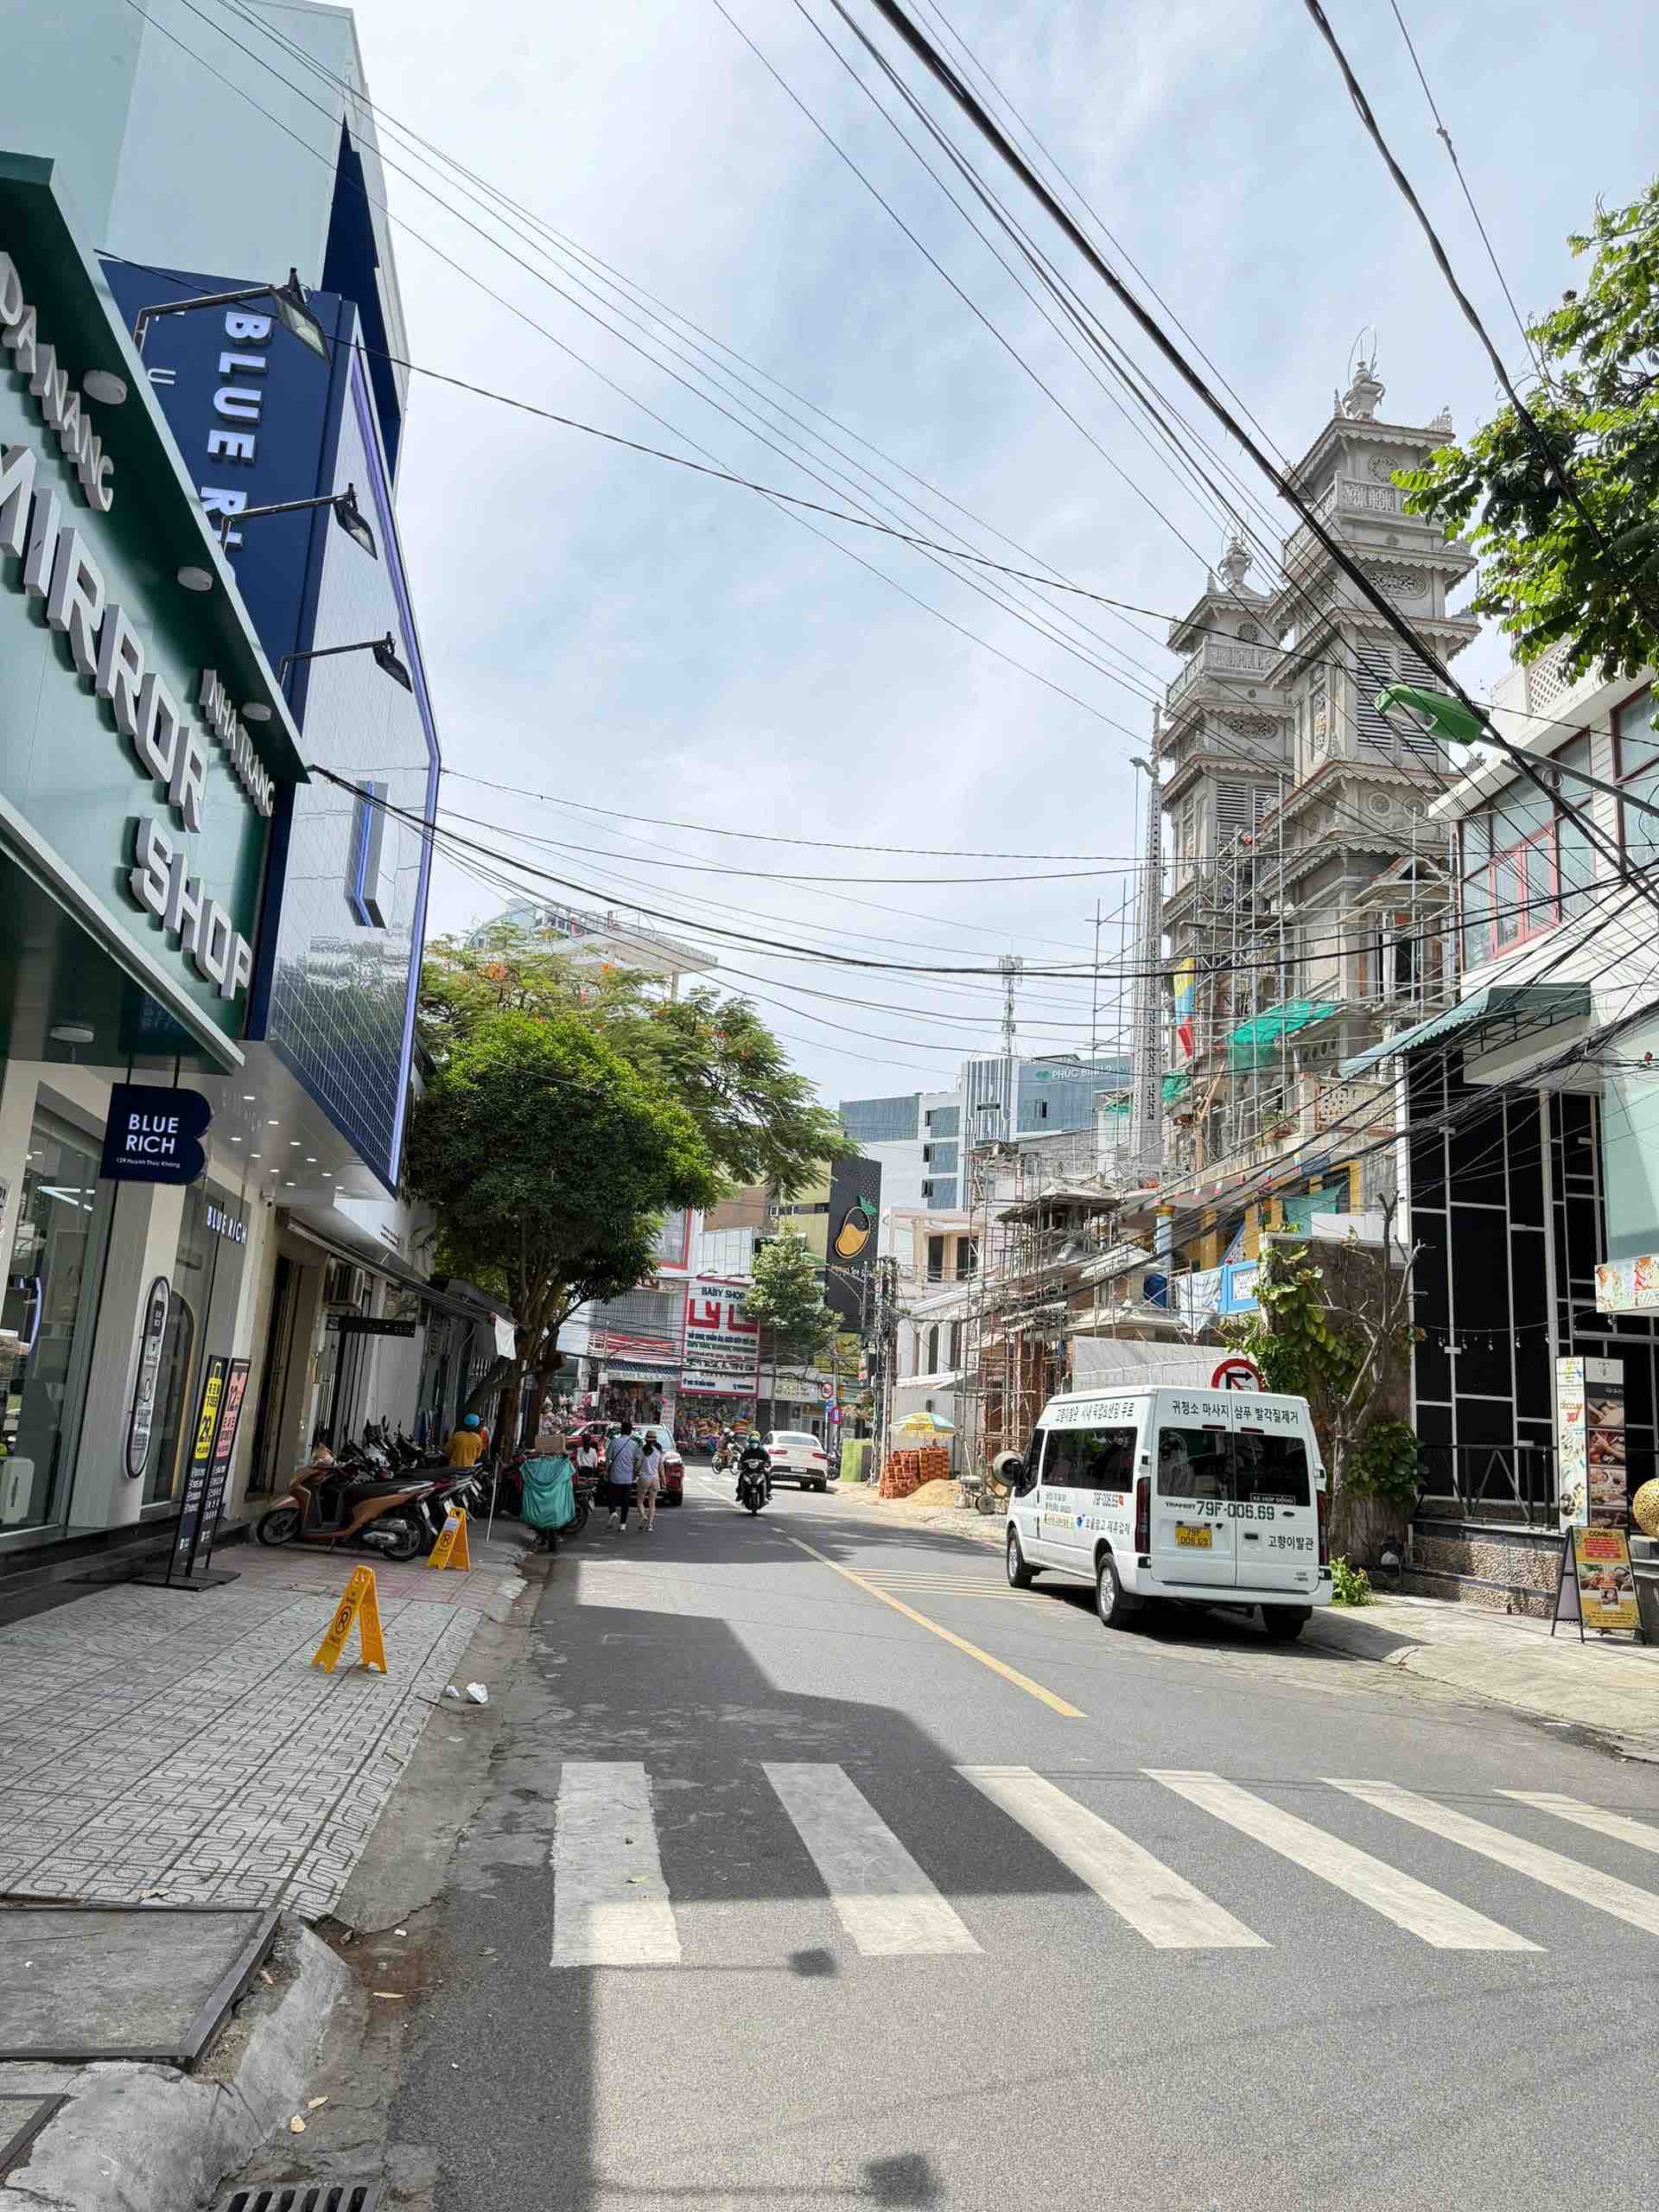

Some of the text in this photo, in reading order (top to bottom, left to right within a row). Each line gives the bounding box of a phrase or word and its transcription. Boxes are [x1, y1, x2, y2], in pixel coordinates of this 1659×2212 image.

[207, 311, 272, 465] BLUE
[199, 669, 237, 750] NHA
[130, 816, 253, 1001] SHOP
[128, 1113, 180, 1134] BLUE
[125, 1135, 175, 1154] RICH
[207, 1205, 248, 1244] BLUE RICH
[702, 1287, 746, 1300] BABY SHOP
[689, 1299, 720, 1330] LY
[1172, 1400, 1198, 1415] 귀청소
[1202, 1402, 1230, 1417] 마사지
[1255, 1408, 1299, 1425] 발각질제거
[1197, 1500, 1274, 1521] 79F-006.69
[1268, 1535, 1314, 1551] 고향이발관
